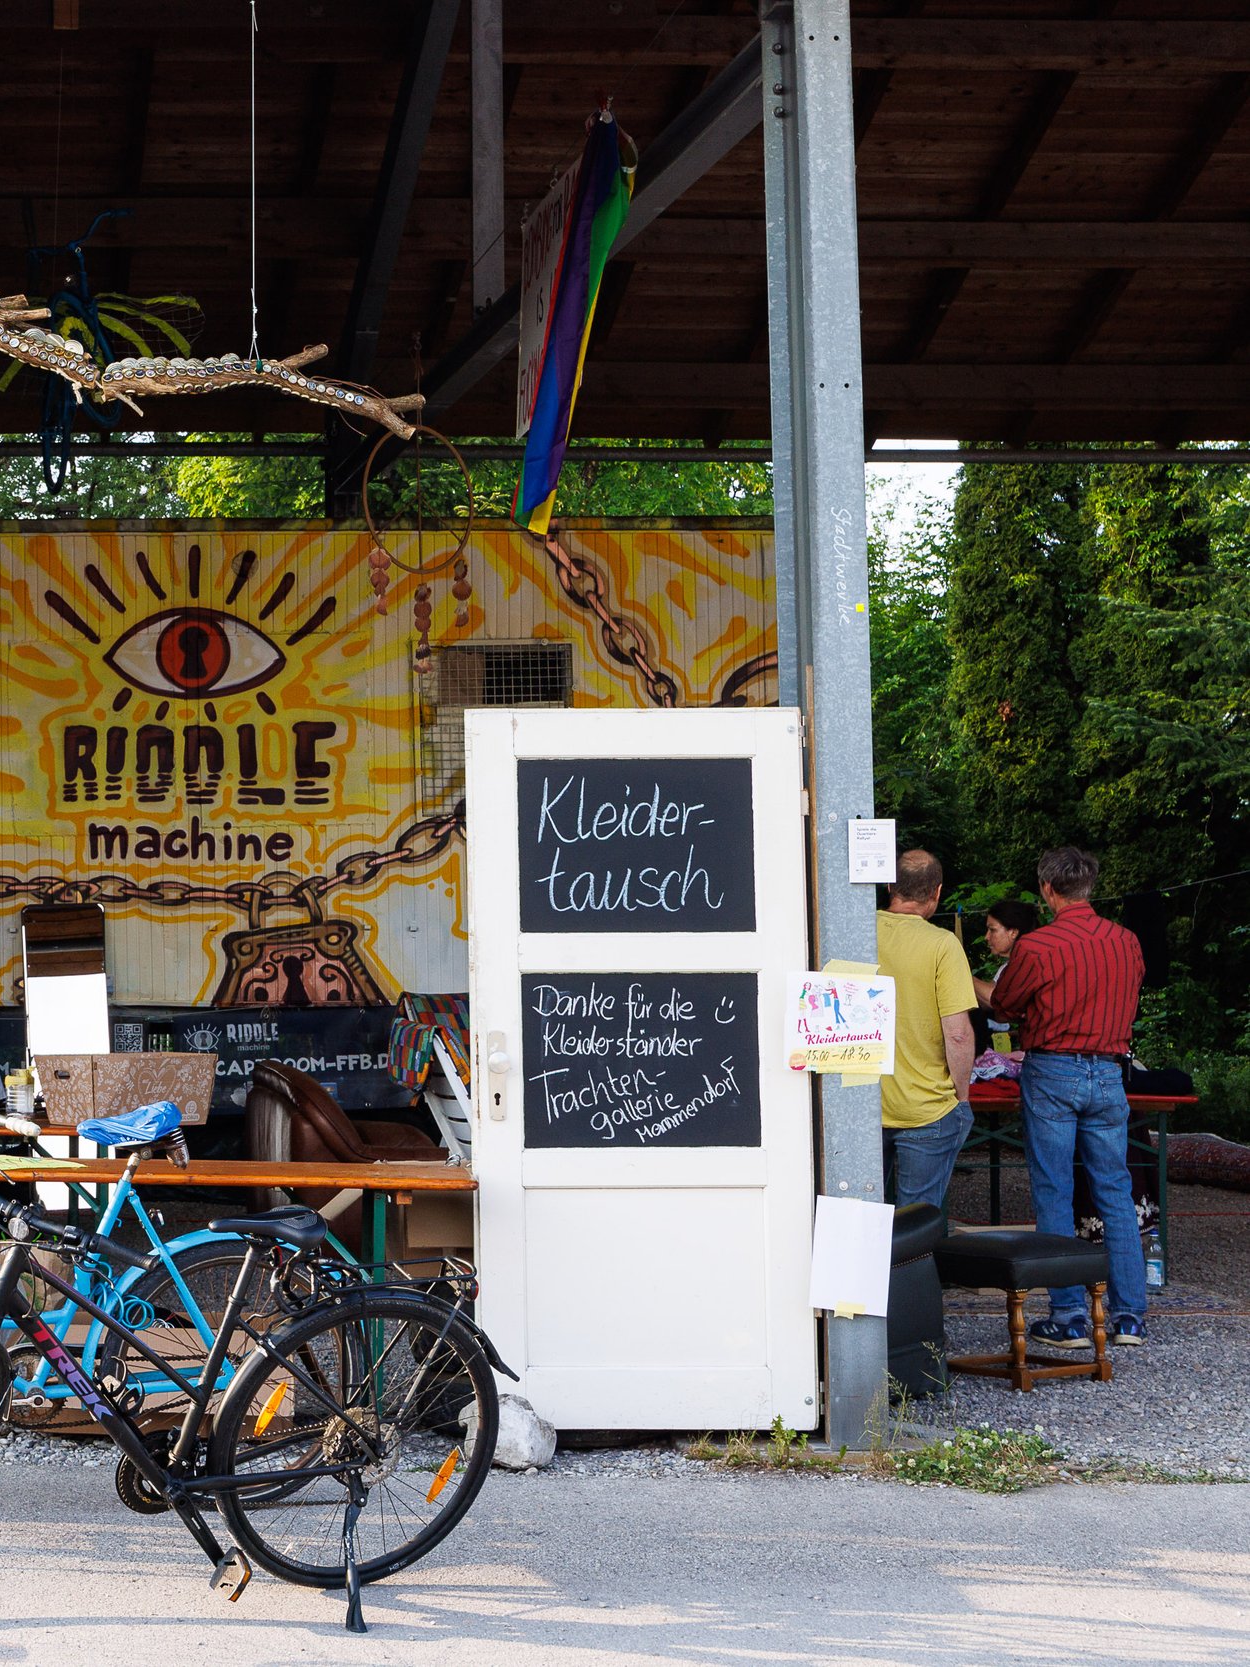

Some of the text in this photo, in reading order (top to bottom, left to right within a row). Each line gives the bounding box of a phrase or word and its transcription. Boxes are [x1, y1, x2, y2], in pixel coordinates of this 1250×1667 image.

[63, 721, 336, 805] RIDDLE
[538, 775, 714, 843] Kleider-
[89, 815, 294, 862] machine
[535, 844, 724, 912] tausch
[532, 982, 696, 1032] Danke für die
[226, 1023, 278, 1043] RIDDLE
[237, 1043, 270, 1051] machine
[805, 1029, 883, 1045] Kleidertausch
[805, 1049, 829, 1061] 15.00
[840, 1046, 870, 1061] 18.30
[144, 1081, 167, 1095] Liebe
[529, 1066, 666, 1125] Trachten-
[33, 1319, 114, 1420] TREK
